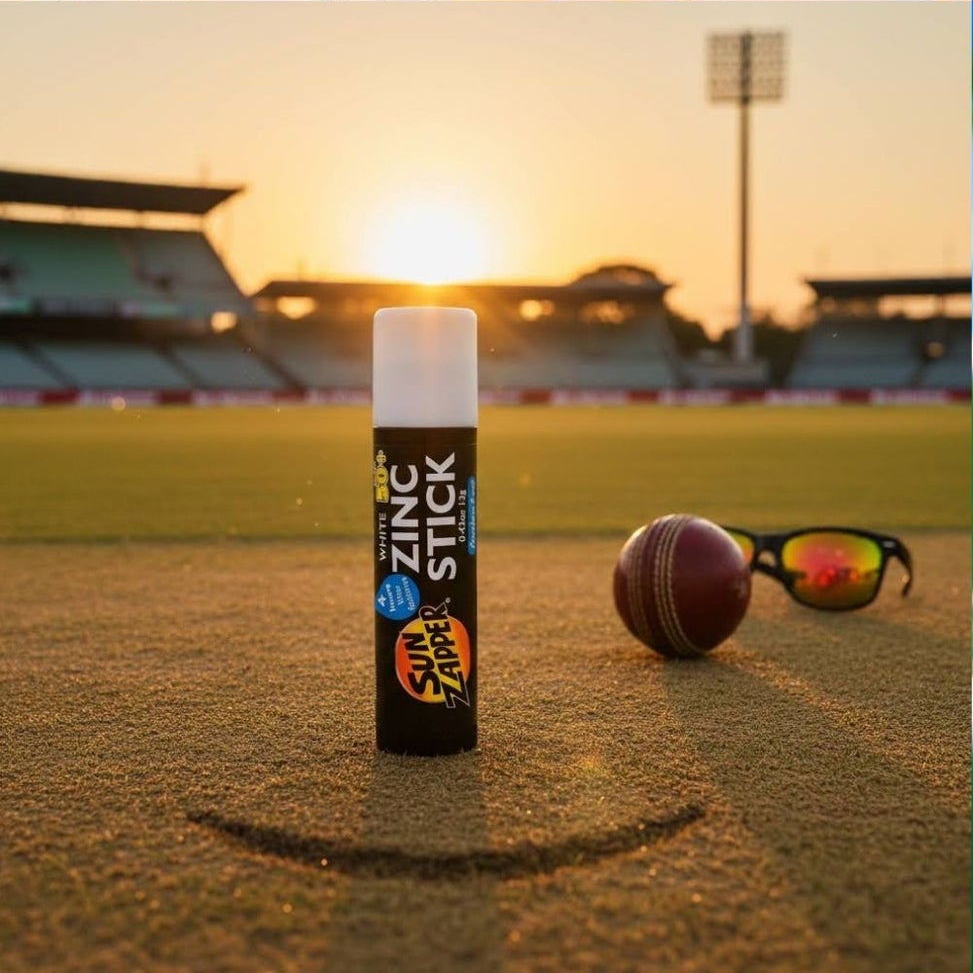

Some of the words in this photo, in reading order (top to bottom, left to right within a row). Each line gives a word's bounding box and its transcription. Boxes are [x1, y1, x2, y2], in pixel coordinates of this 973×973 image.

[378, 512, 387, 561] WHITE
[390, 464, 420, 574] ZINC
[425, 452, 457, 581] STICK
[401, 632, 442, 696] SUN
[418, 604, 471, 709] ZAPPER
